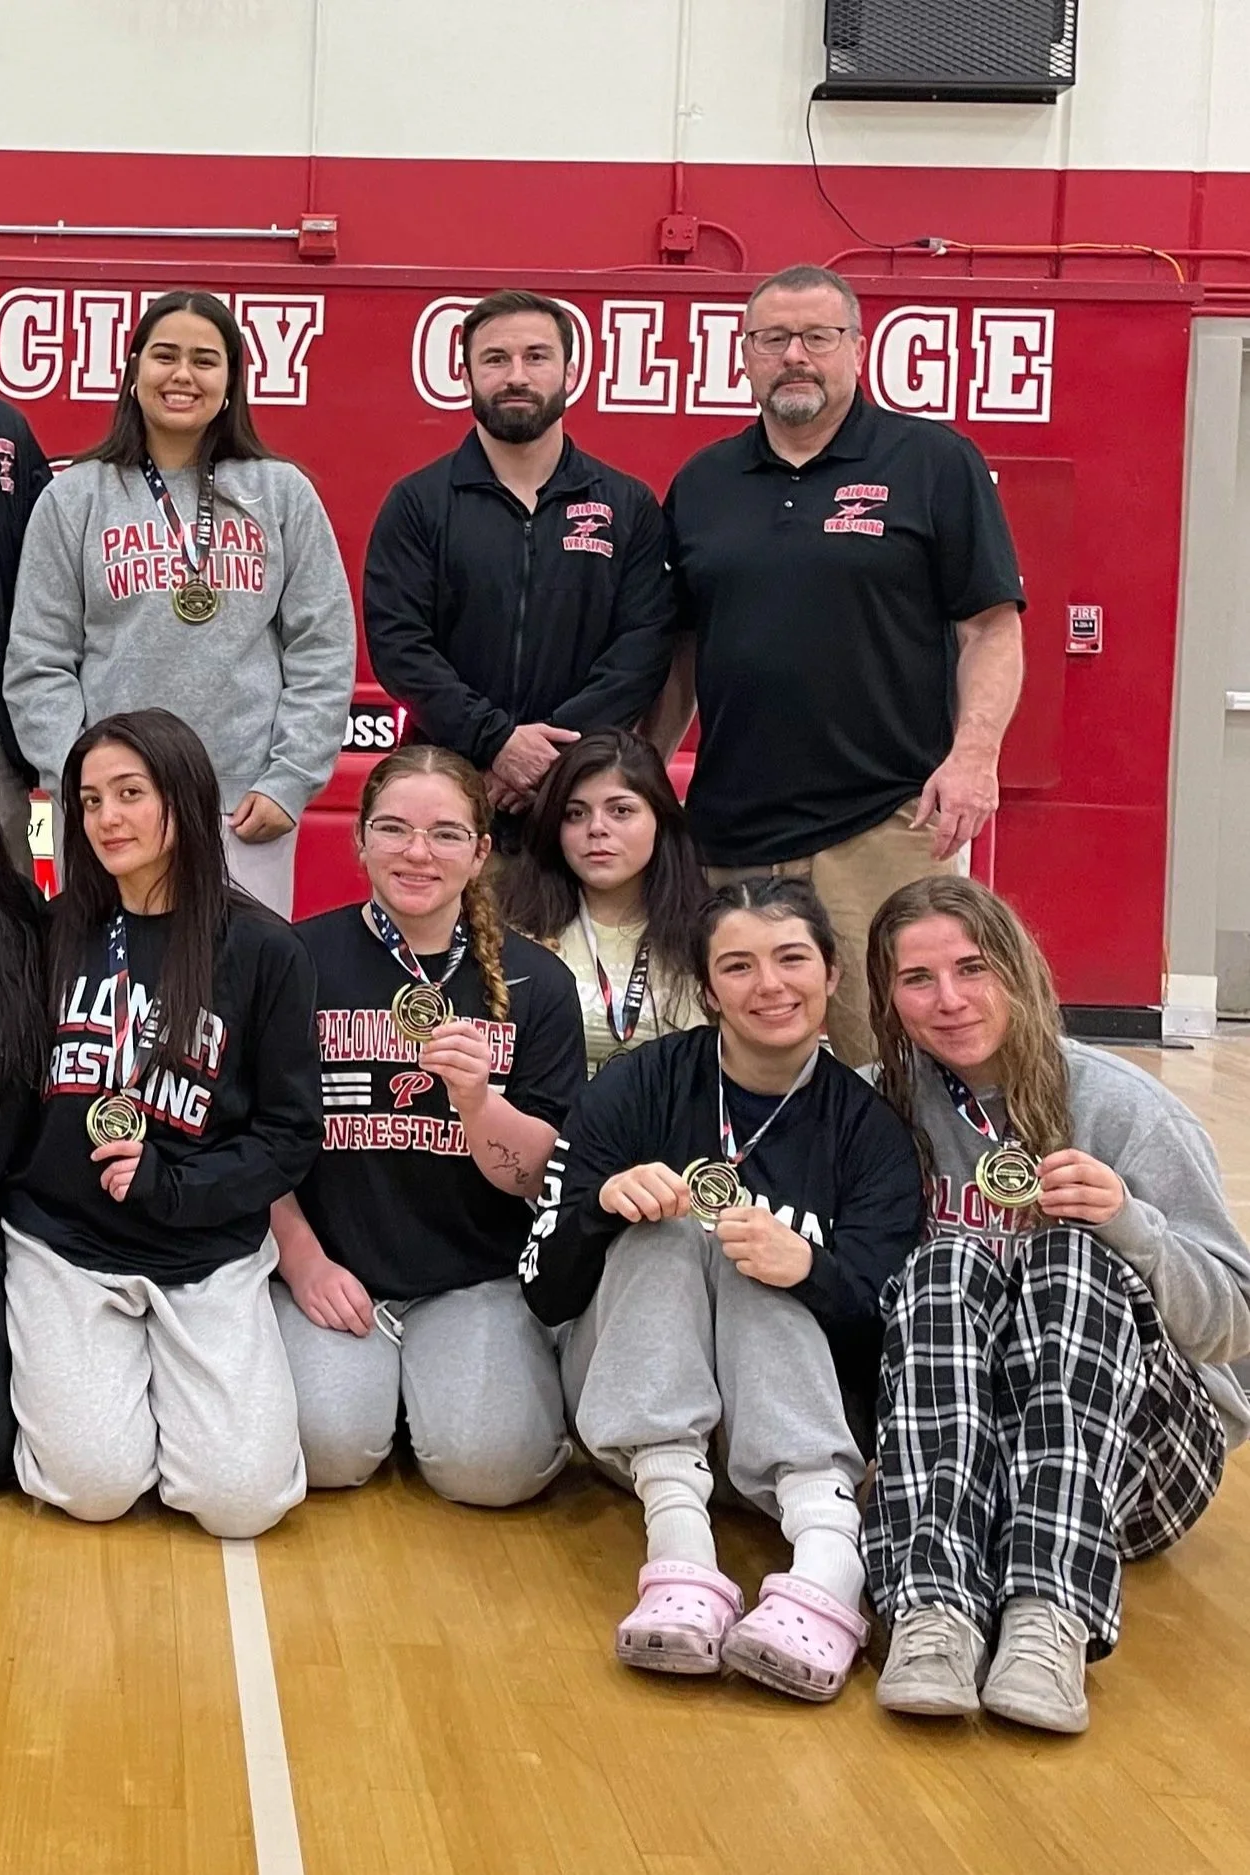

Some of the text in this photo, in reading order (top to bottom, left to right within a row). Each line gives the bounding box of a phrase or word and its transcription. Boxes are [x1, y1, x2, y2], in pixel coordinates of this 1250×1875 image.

[197, 510, 211, 546] FIRST
[105, 553, 266, 602] WRESLING
[625, 966, 647, 1008] FIRST
